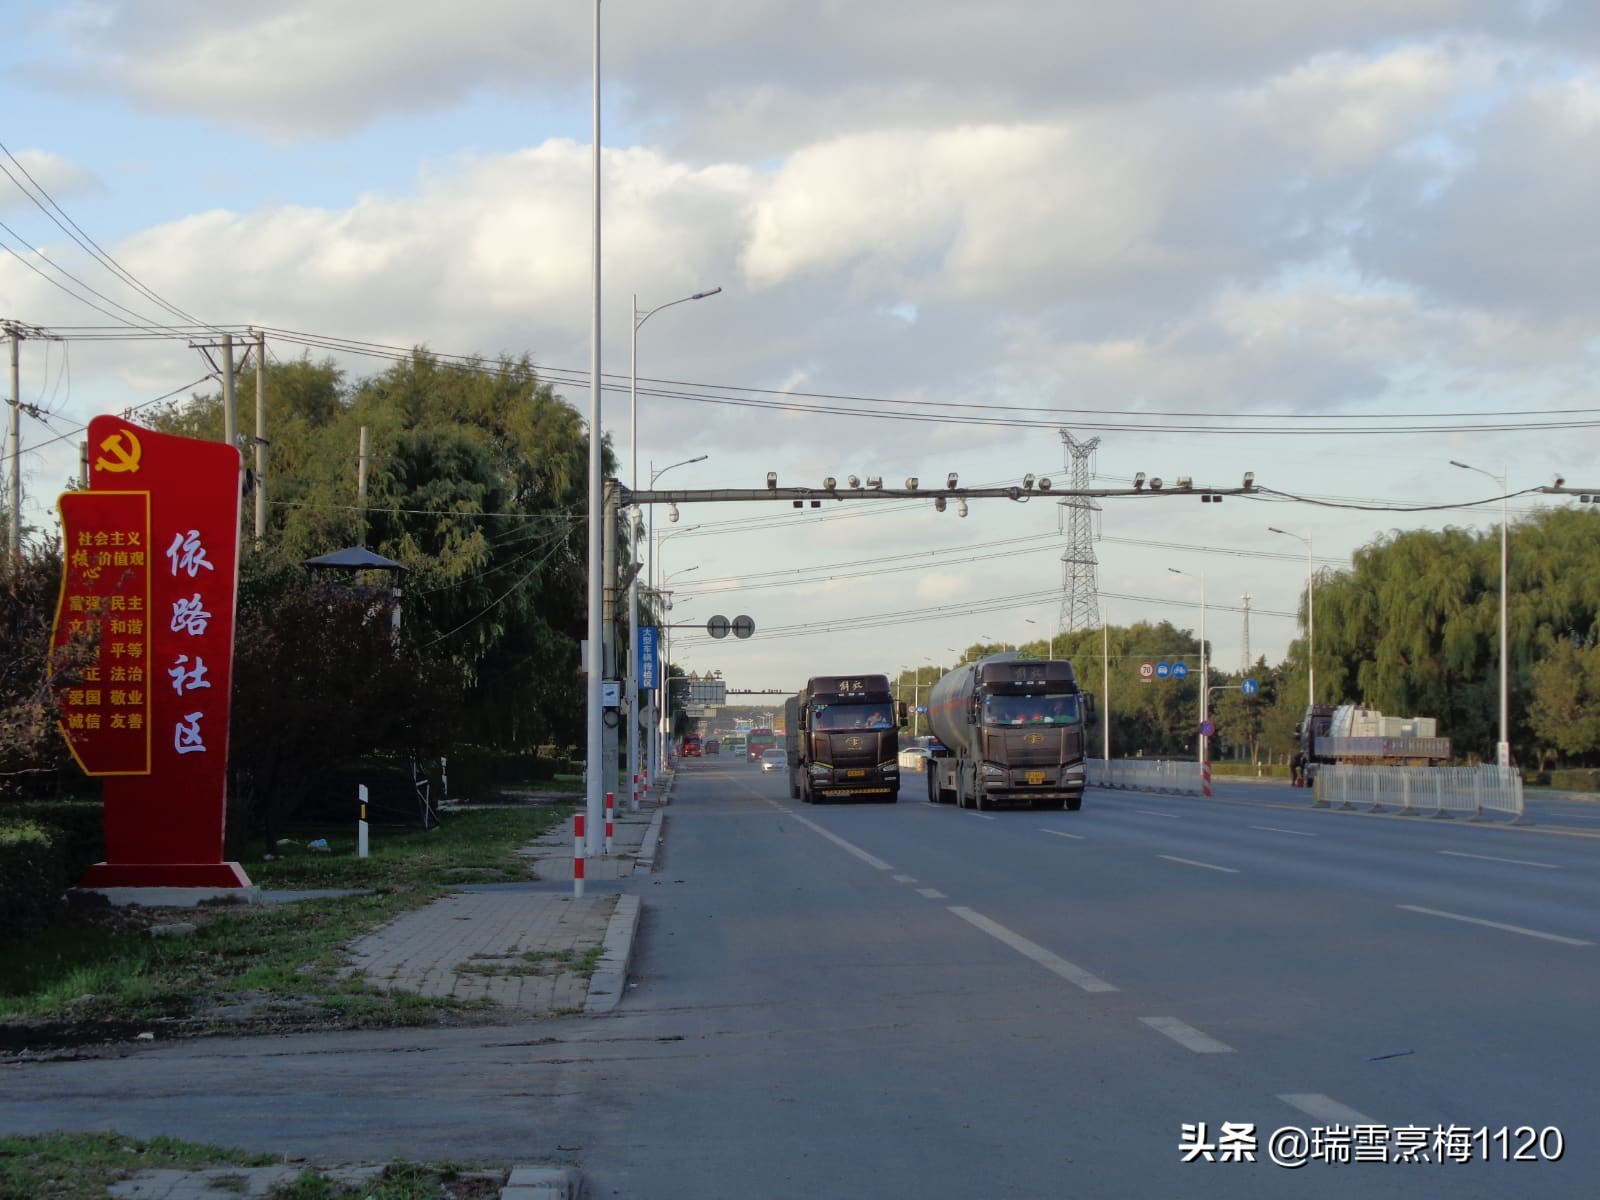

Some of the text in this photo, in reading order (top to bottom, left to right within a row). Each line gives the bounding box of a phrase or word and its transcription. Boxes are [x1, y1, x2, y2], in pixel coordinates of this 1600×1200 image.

[78, 531, 141, 546] 社会主义
[111, 595, 143, 611] 民主
[110, 618, 143, 635] 和谐
[110, 642, 143, 658] 平等
[166, 529, 214, 755] 依路社区
[110, 666, 143, 682] 法治
[1143, 666, 1151, 674] 70
[69, 690, 143, 705] 爱国 敬业
[68, 713, 143, 729] 诚信 友善
